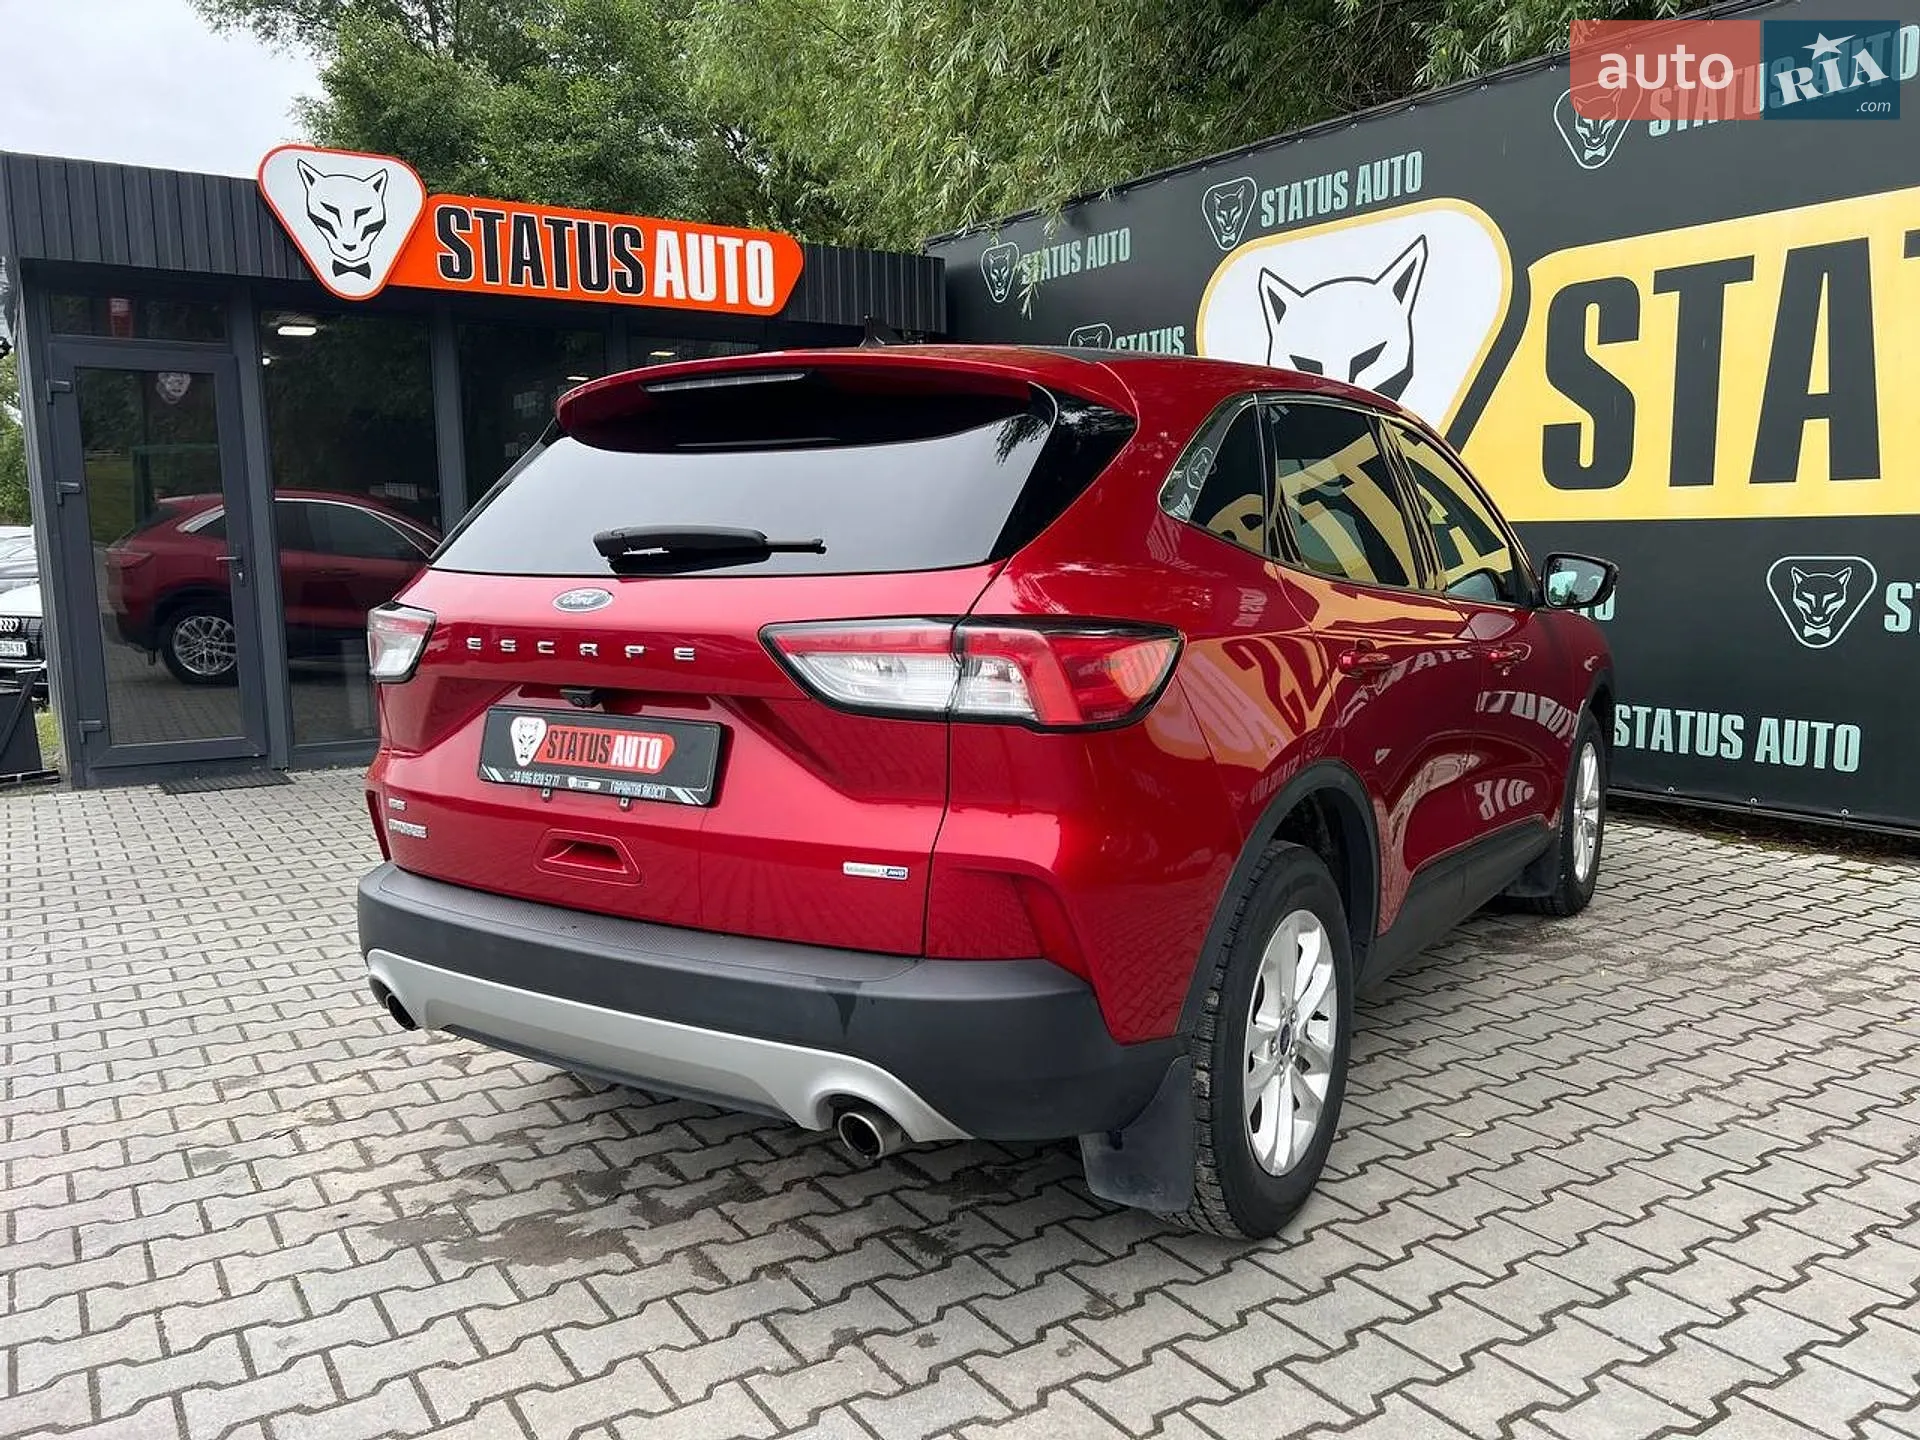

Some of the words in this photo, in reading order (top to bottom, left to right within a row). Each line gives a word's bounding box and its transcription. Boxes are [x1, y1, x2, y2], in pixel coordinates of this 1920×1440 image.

[1261, 169, 1349, 228] STATUS
[1356, 150, 1423, 206] AUTO
[434, 204, 646, 298] STATUS
[653, 229, 774, 307] AUTO
[1020, 240, 1082, 285] STATUS
[1086, 227, 1131, 271] AUTO
[1542, 227, 1920, 491] STA
[1884, 582, 1920, 632] S
[547, 729, 611, 765] STATUS
[611, 735, 664, 769] AUTO
[1613, 703, 1745, 760] STATUS
[1754, 716, 1862, 773] AUTO
